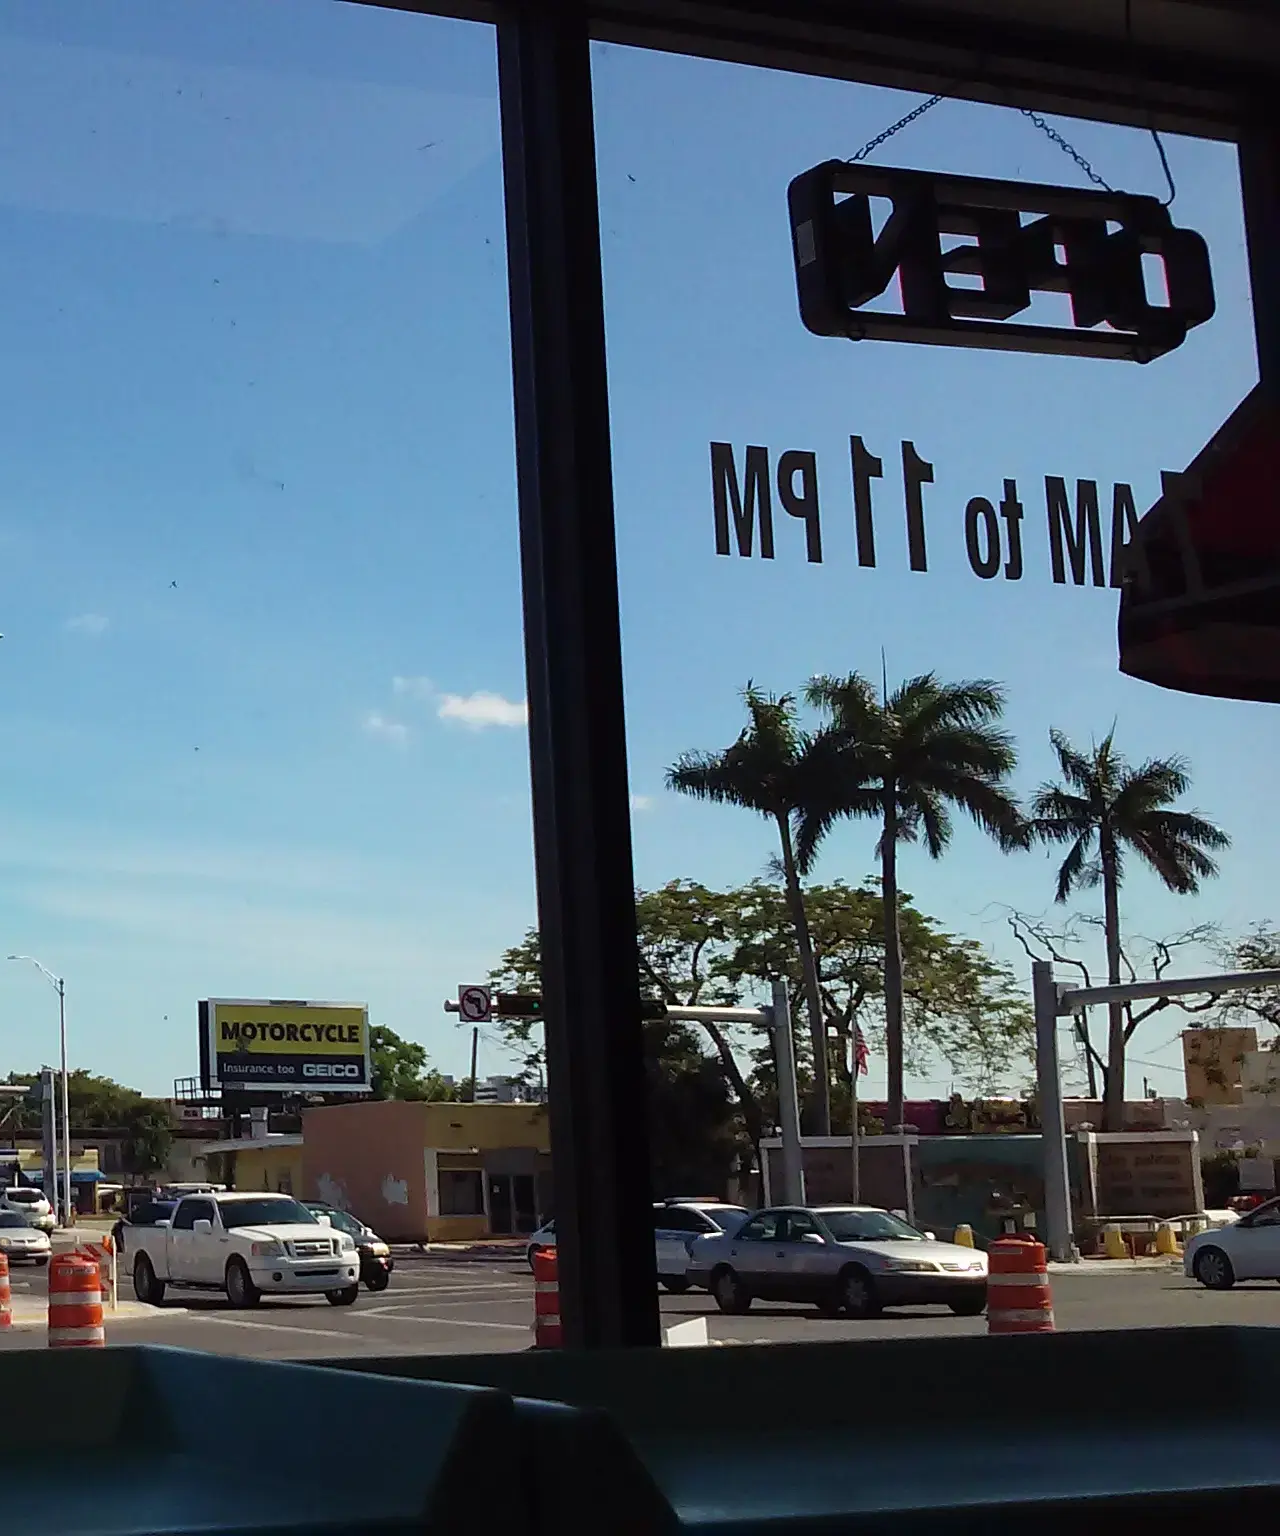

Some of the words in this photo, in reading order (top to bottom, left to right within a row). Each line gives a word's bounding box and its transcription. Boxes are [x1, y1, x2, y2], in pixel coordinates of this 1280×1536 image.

[221, 1021, 359, 1043] MOTORCYCLE
[223, 1062, 274, 1074] Insurance
[277, 1064, 296, 1074] too
[302, 1063, 360, 1077] GEICO
